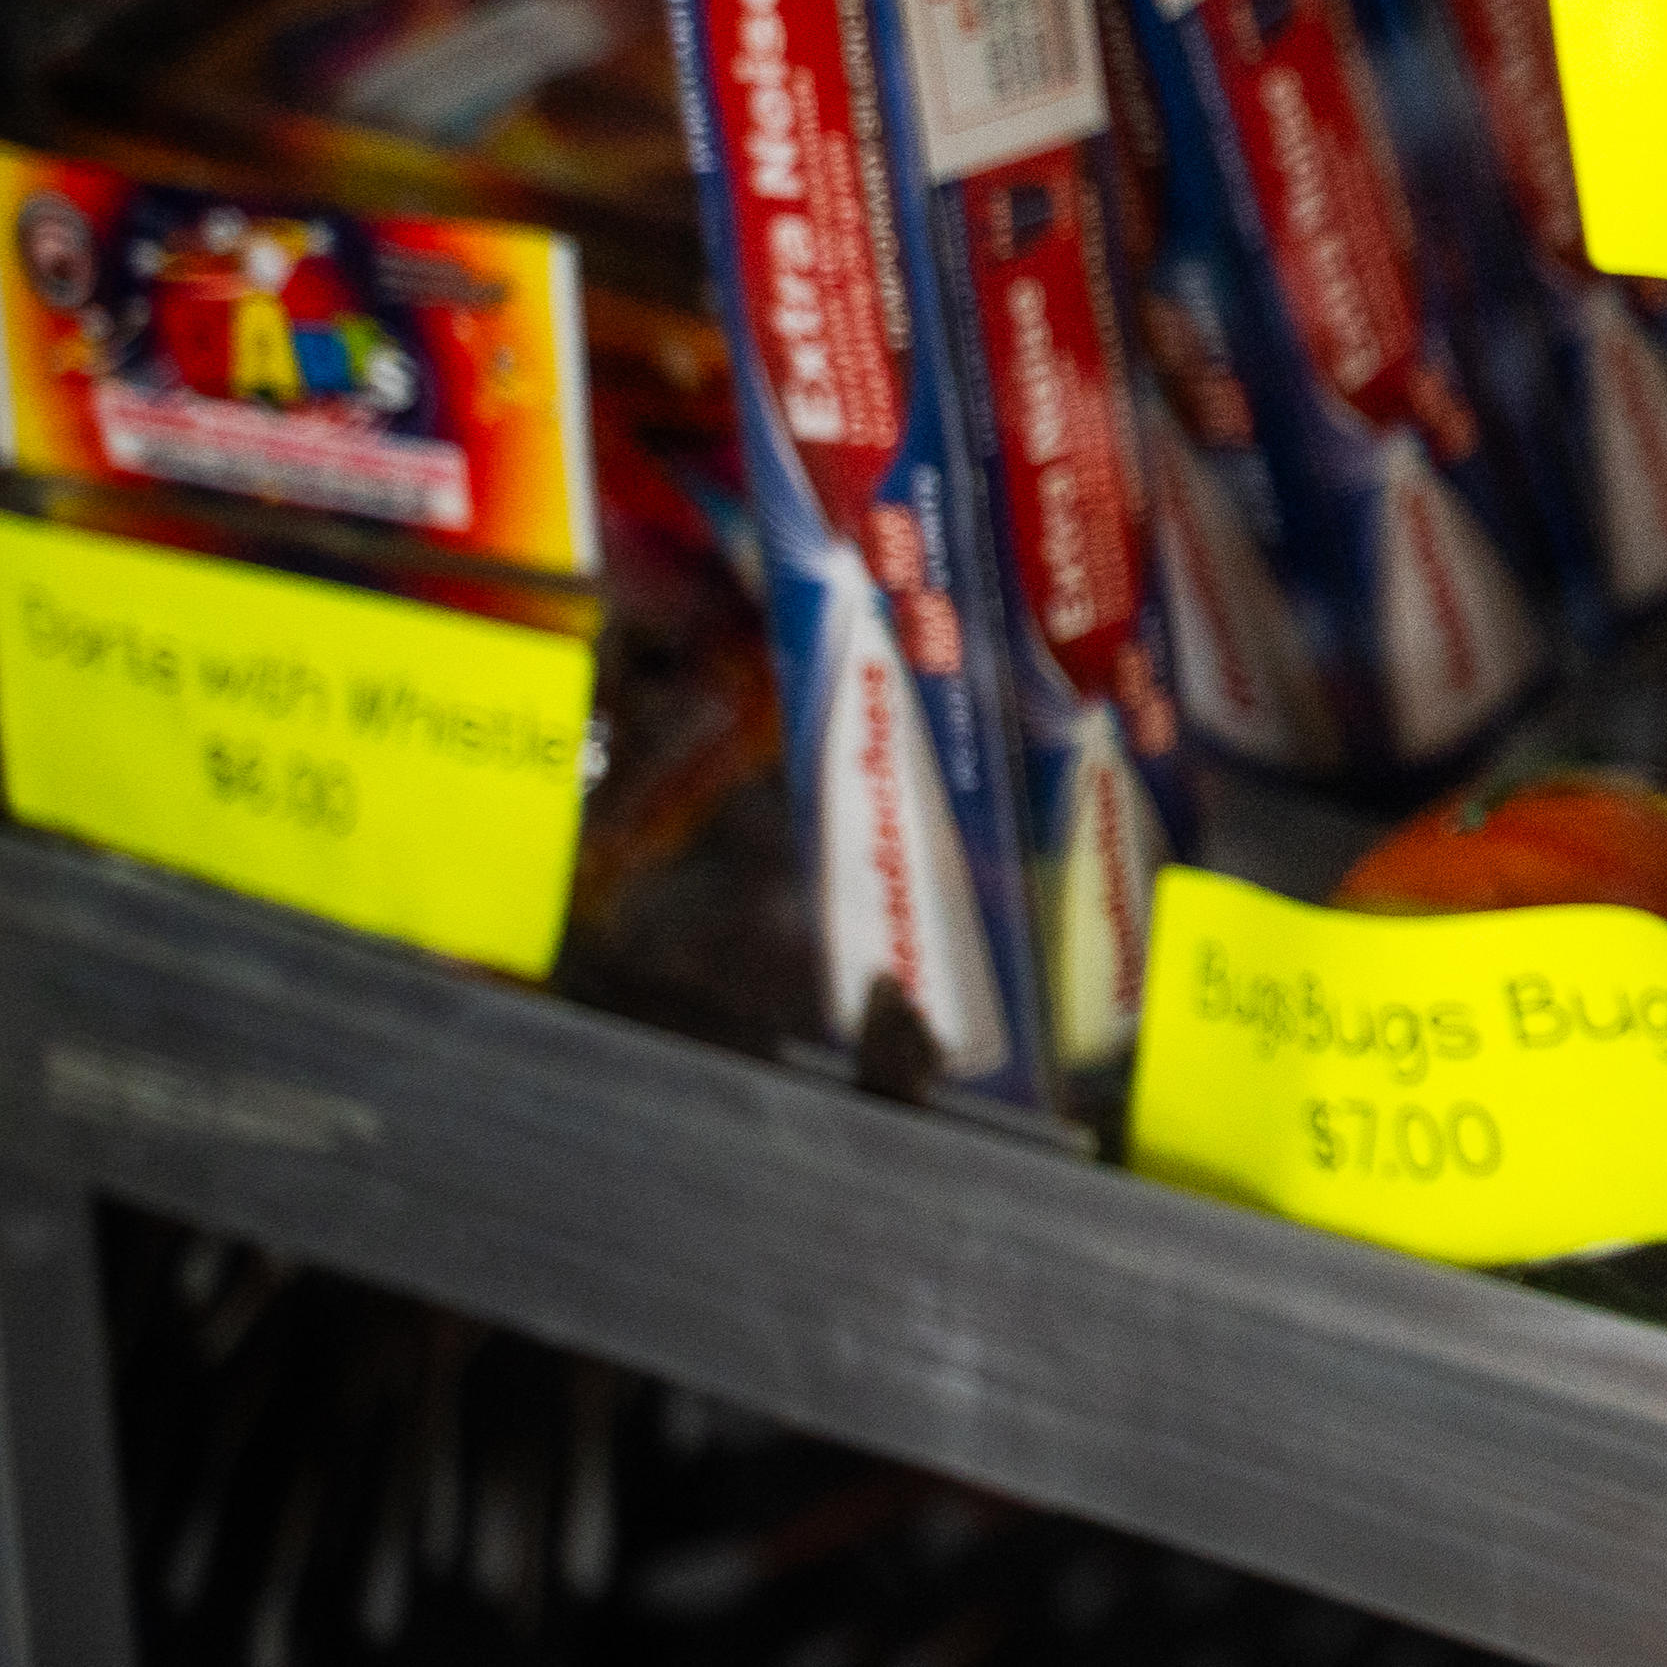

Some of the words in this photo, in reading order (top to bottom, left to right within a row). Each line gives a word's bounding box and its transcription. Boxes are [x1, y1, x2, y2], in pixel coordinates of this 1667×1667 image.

[768, 212, 845, 444] Extra
[858, 659, 927, 1024] eadaches
[1305, 1096, 1505, 1183] $7.00
